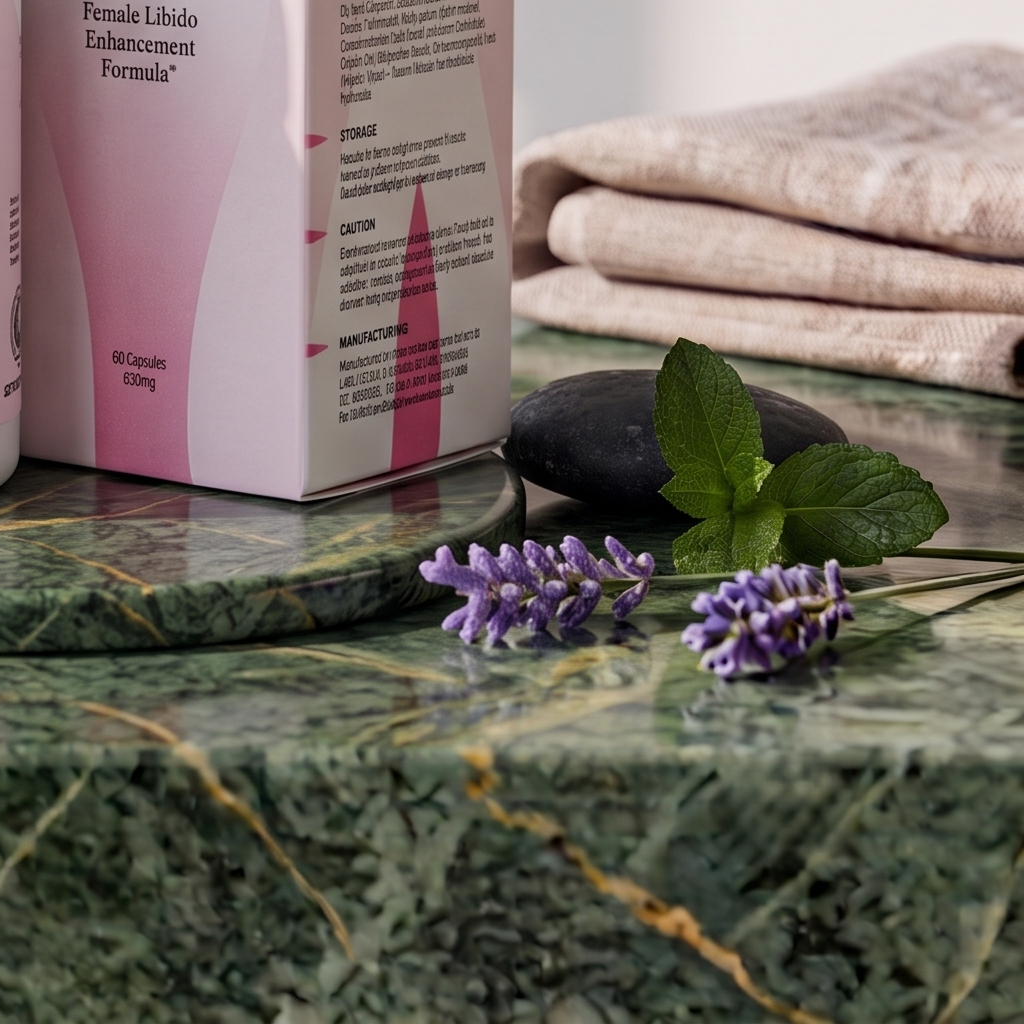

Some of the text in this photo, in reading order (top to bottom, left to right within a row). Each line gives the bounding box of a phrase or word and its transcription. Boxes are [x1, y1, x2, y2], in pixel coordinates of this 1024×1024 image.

[83, 1, 198, 28] Female Libido
[85, 29, 196, 57] Enhancement
[340, 123, 378, 142] STORAGE
[340, 218, 376, 237] CAUTION
[339, 322, 409, 349] MANUFACTURING
[112, 350, 167, 371] 60 Capsules
[123, 372, 156, 393] 630mg
